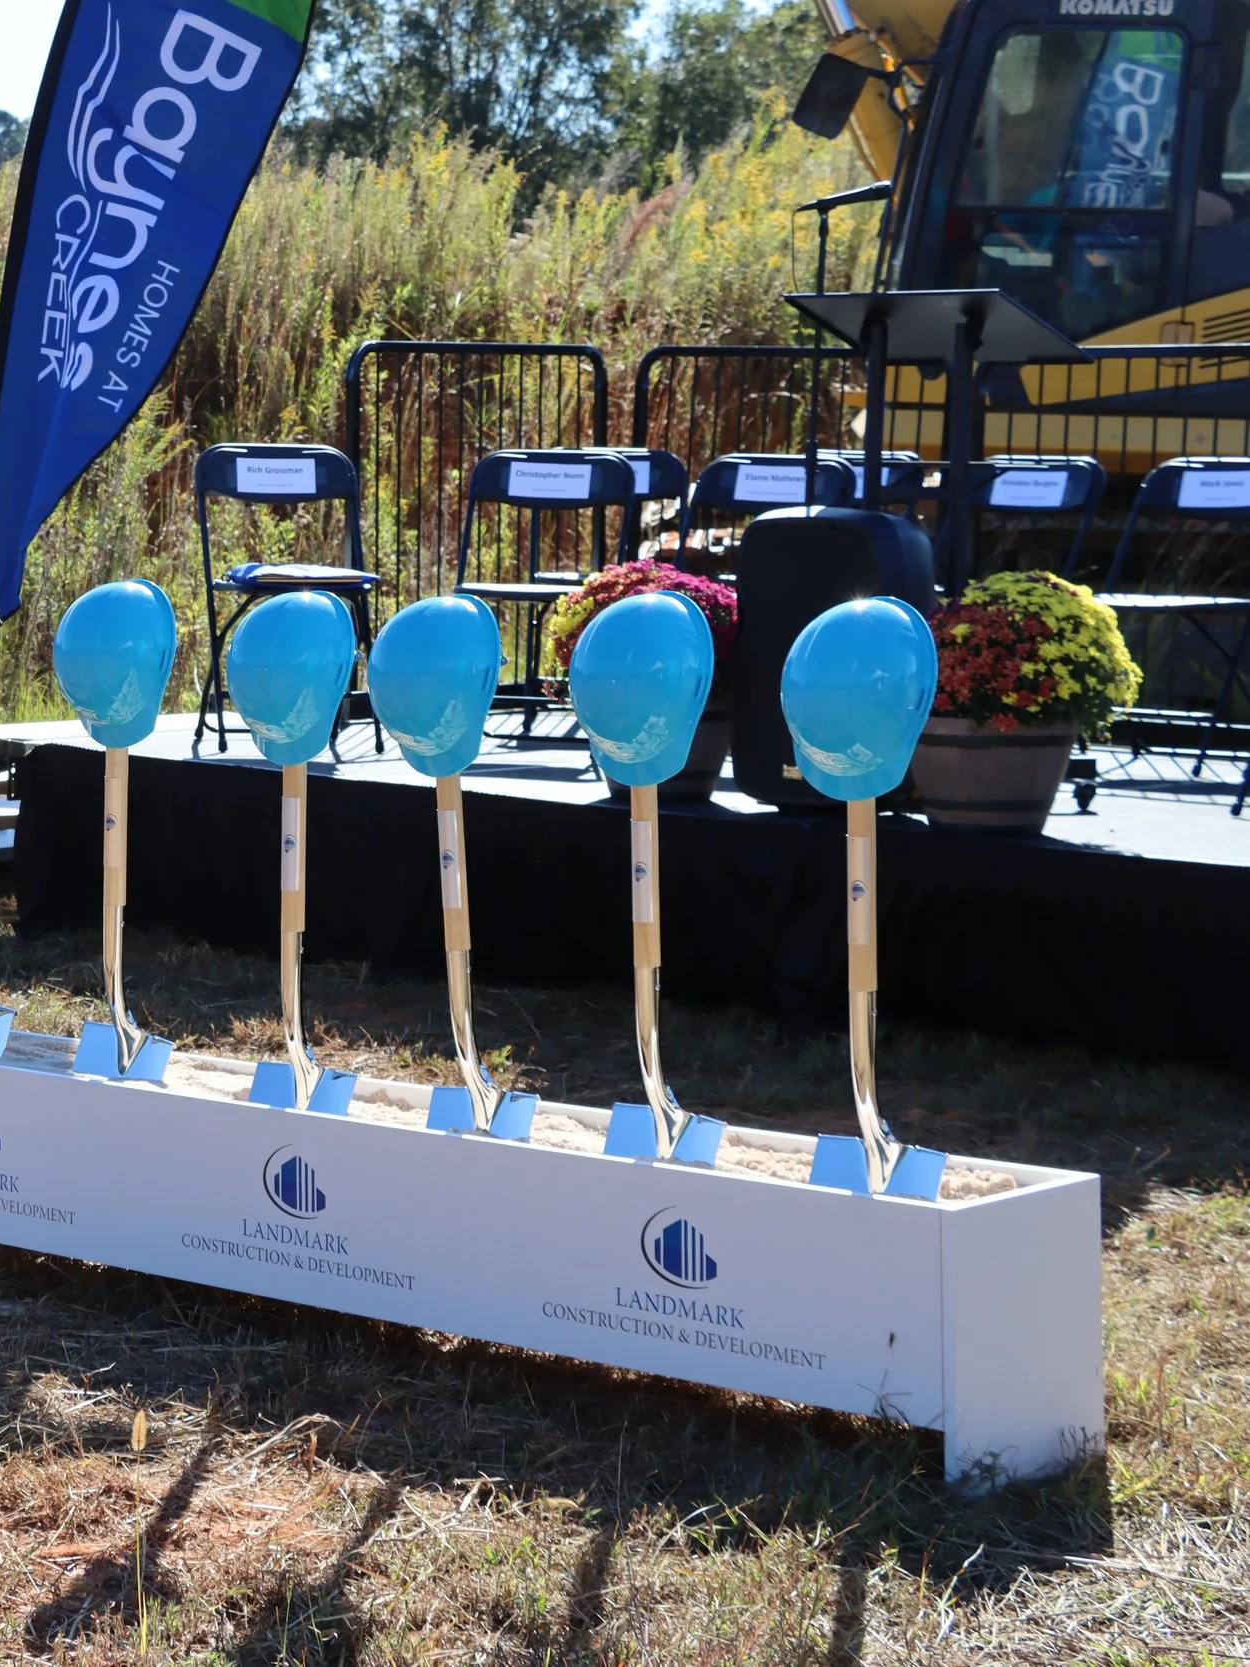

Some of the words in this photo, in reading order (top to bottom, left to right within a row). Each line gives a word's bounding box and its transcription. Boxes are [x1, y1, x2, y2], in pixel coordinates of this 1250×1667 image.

[1059, 0, 1174, 16] KOMATSU
[70, 9, 262, 391] Baynes
[37, 194, 91, 382] CREEK
[116, 260, 180, 368] HOMES
[98, 370, 129, 413] AT
[247, 466, 263, 474] Rich
[265, 466, 304, 474] Grossman
[515, 469, 561, 480] Christopher
[563, 472, 585, 480] Nunn
[745, 473, 769, 482] Elaine
[241, 1218, 349, 1255] LANDMARK
[181, 1233, 290, 1267] CONSTRUCTION
[294, 1255, 304, 1270] &
[308, 1256, 415, 1291] DEVELOPMENT
[615, 1287, 745, 1330] LANDMARK
[542, 1302, 673, 1340] CONSTRUCTION
[678, 1328, 691, 1344] &
[695, 1330, 827, 1370] DEVELOPMENT
